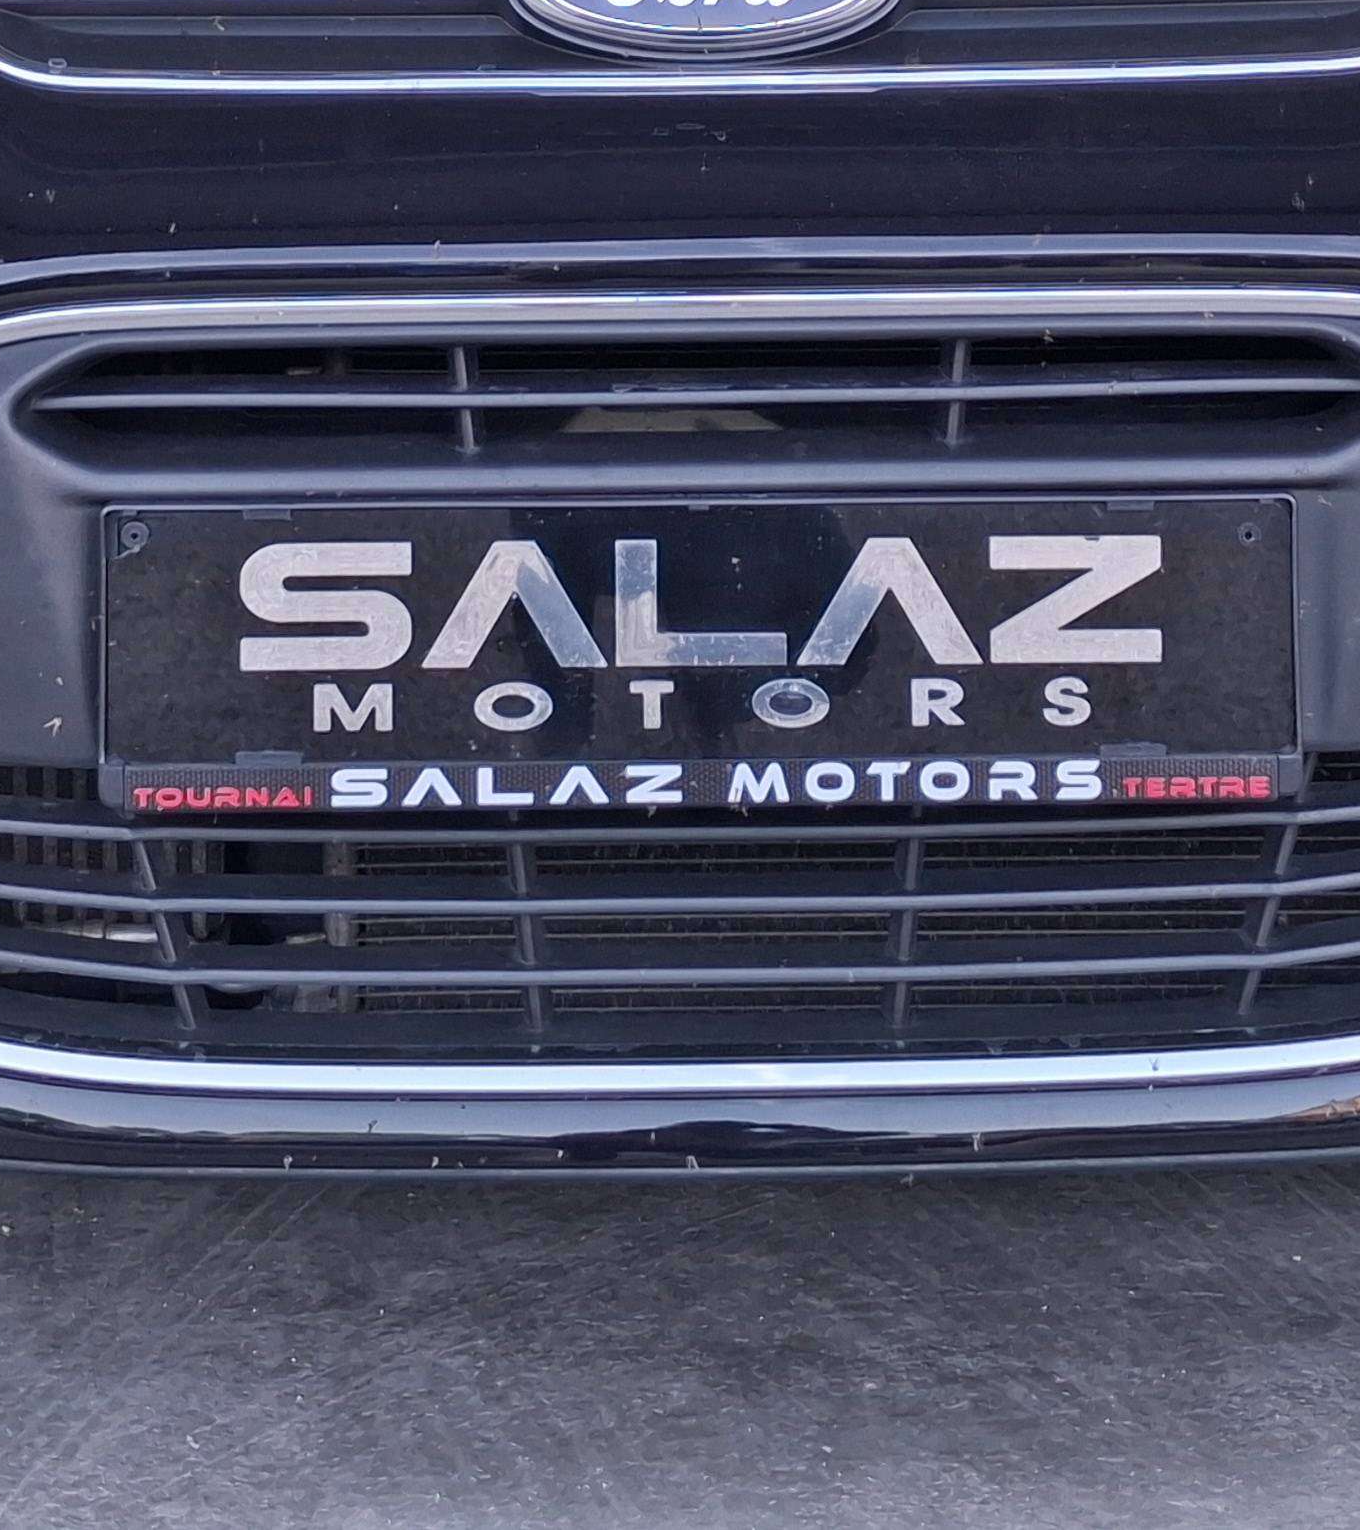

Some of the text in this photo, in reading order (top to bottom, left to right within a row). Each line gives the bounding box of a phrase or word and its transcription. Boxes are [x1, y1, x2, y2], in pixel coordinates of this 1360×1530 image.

[239, 535, 1164, 672] SALAZ
[311, 676, 1093, 734] MOTORS
[133, 760, 1272, 810] TOURNAI SALAZ MOTORS TERTRE
